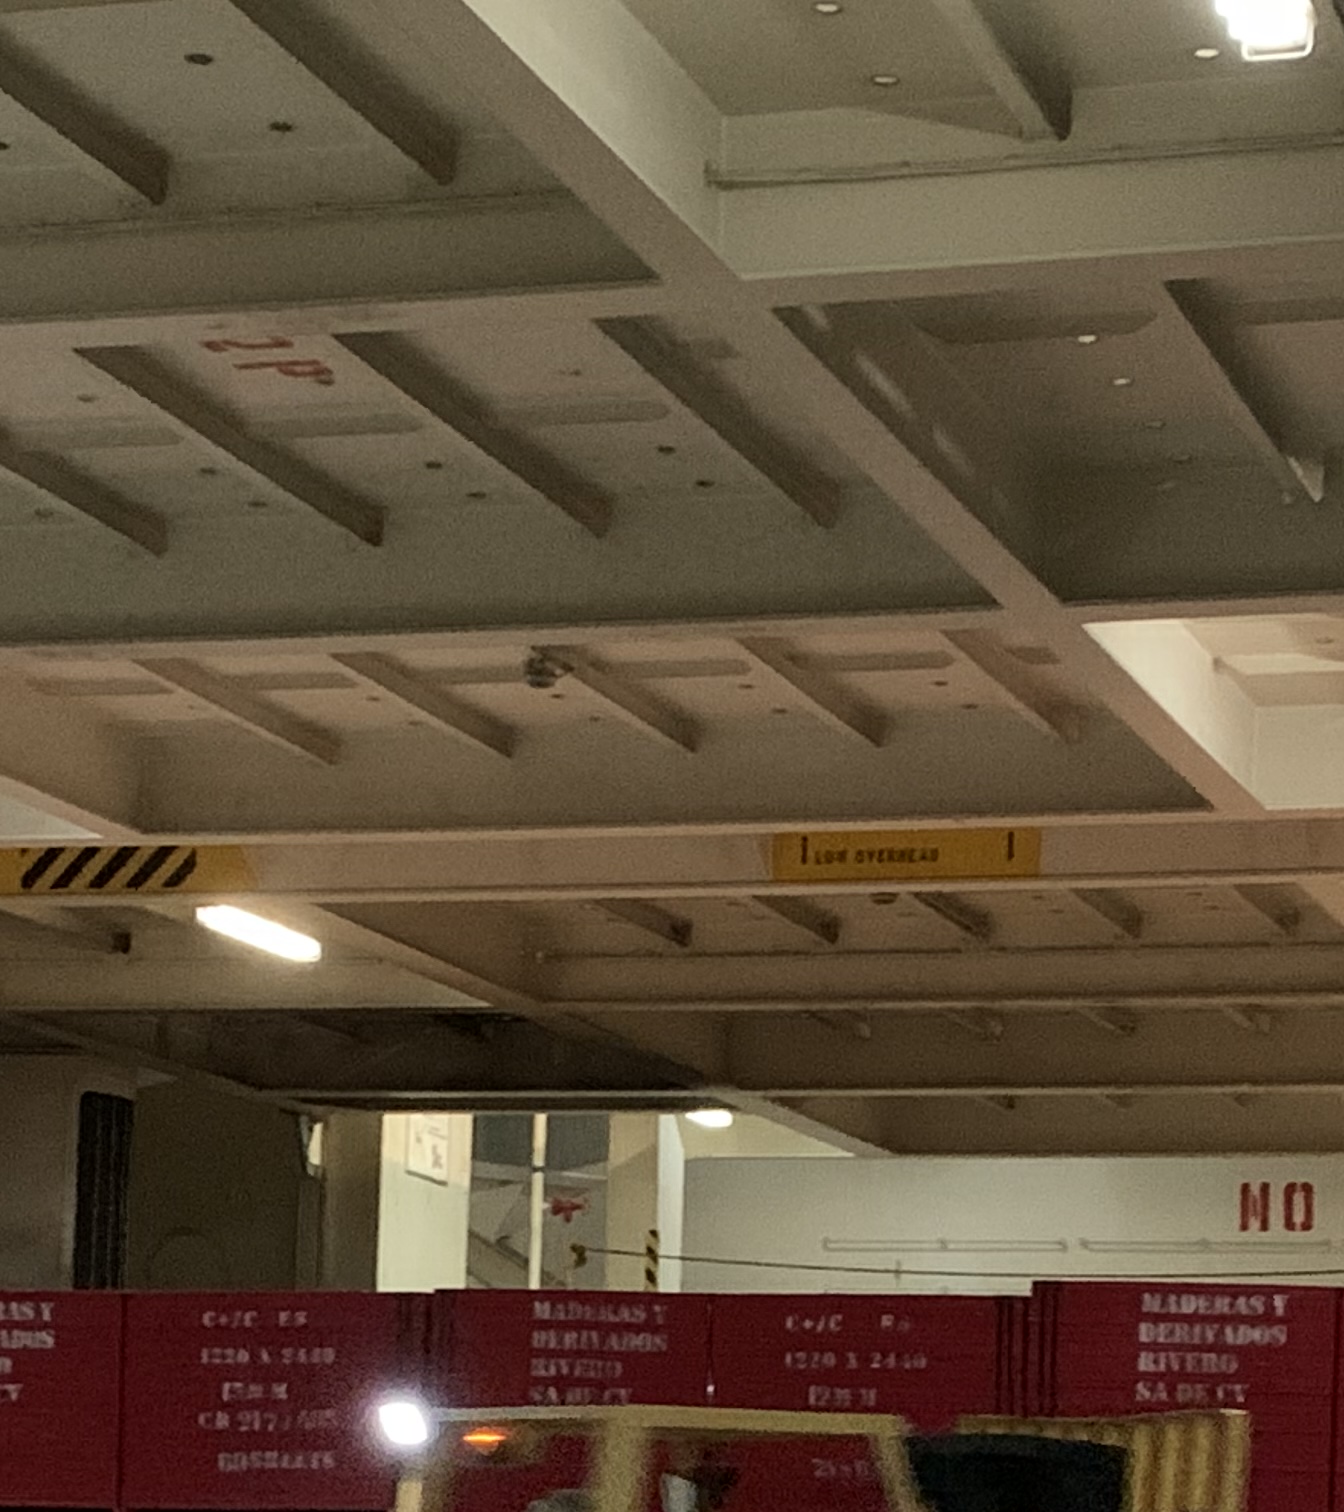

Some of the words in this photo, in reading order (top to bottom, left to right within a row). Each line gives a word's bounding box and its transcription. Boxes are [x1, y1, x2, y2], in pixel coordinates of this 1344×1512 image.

[813, 848, 848, 866] LOW
[854, 846, 941, 865] OVERHEAD
[1238, 1181, 1316, 1233] NO
[40, 1301, 55, 1322] Y
[1141, 1292, 1267, 1316] MADERAS
[1272, 1293, 1290, 1317] Y
[1138, 1321, 1288, 1348] DERIVADOS
[784, 1351, 837, 1370] 1220
[869, 1351, 928, 1370] 2440
[1137, 1351, 1239, 1374] RIVERO
[1135, 1381, 1169, 1402] SA
[1175, 1382, 1211, 1405] DE
[1215, 1383, 1250, 1403] CV
